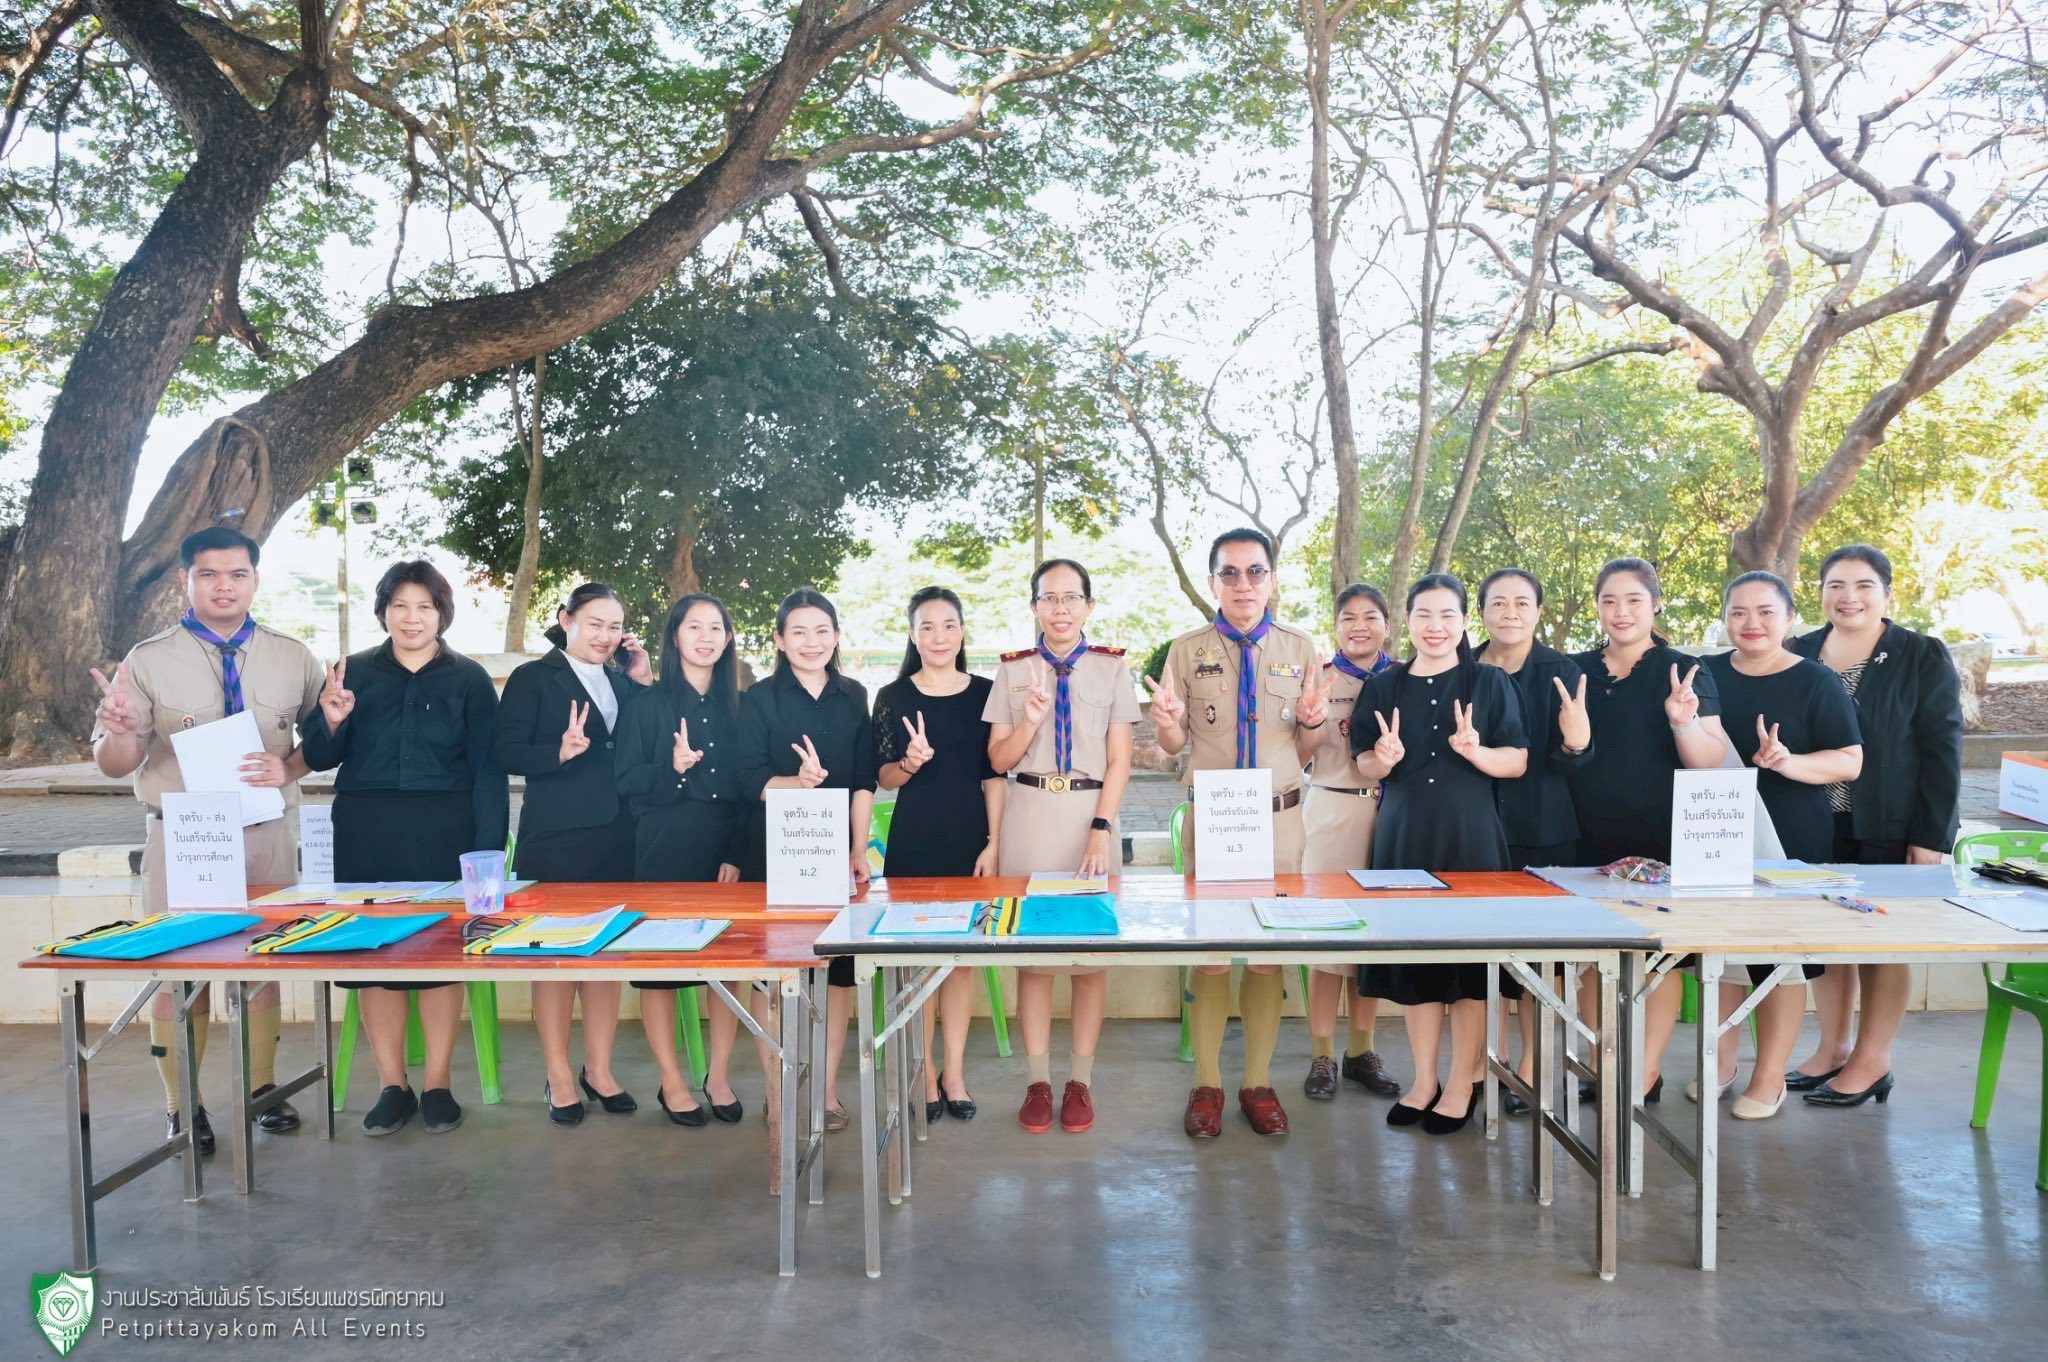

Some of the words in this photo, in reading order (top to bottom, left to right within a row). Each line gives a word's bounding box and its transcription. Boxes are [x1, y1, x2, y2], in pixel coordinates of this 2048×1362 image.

[1210, 787, 1235, 802] จุดรับ
[1246, 787, 1257, 798] ส่ง
[1690, 788, 1716, 804] จุดรับ
[1728, 788, 1740, 799] ส่ง
[178, 811, 203, 825] จุดรับ
[214, 811, 226, 822] ส่ง
[783, 807, 808, 822] จุดรับ
[821, 807, 833, 819] ส่ง
[1209, 807, 1259, 817] ใบเสร็จรับเงิน
[1683, 808, 1745, 821] ใบเสร็จรับเงิน
[782, 827, 834, 838] ใบเสร็จรับเงิน
[1208, 823, 1261, 836] บำรุงการศึกษา
[1683, 828, 1744, 842] บำรุงการศึกษา
[174, 830, 232, 843] ใบเสร็จรับเงิน
[780, 845, 836, 859] บำรุงการศึกษา
[1226, 843, 1243, 853] ม.3
[1705, 850, 1720, 859] ม.4
[176, 850, 233, 864] บำรุงการศึกษา
[198, 872, 213, 882] ม.1
[799, 867, 817, 877] ม.2
